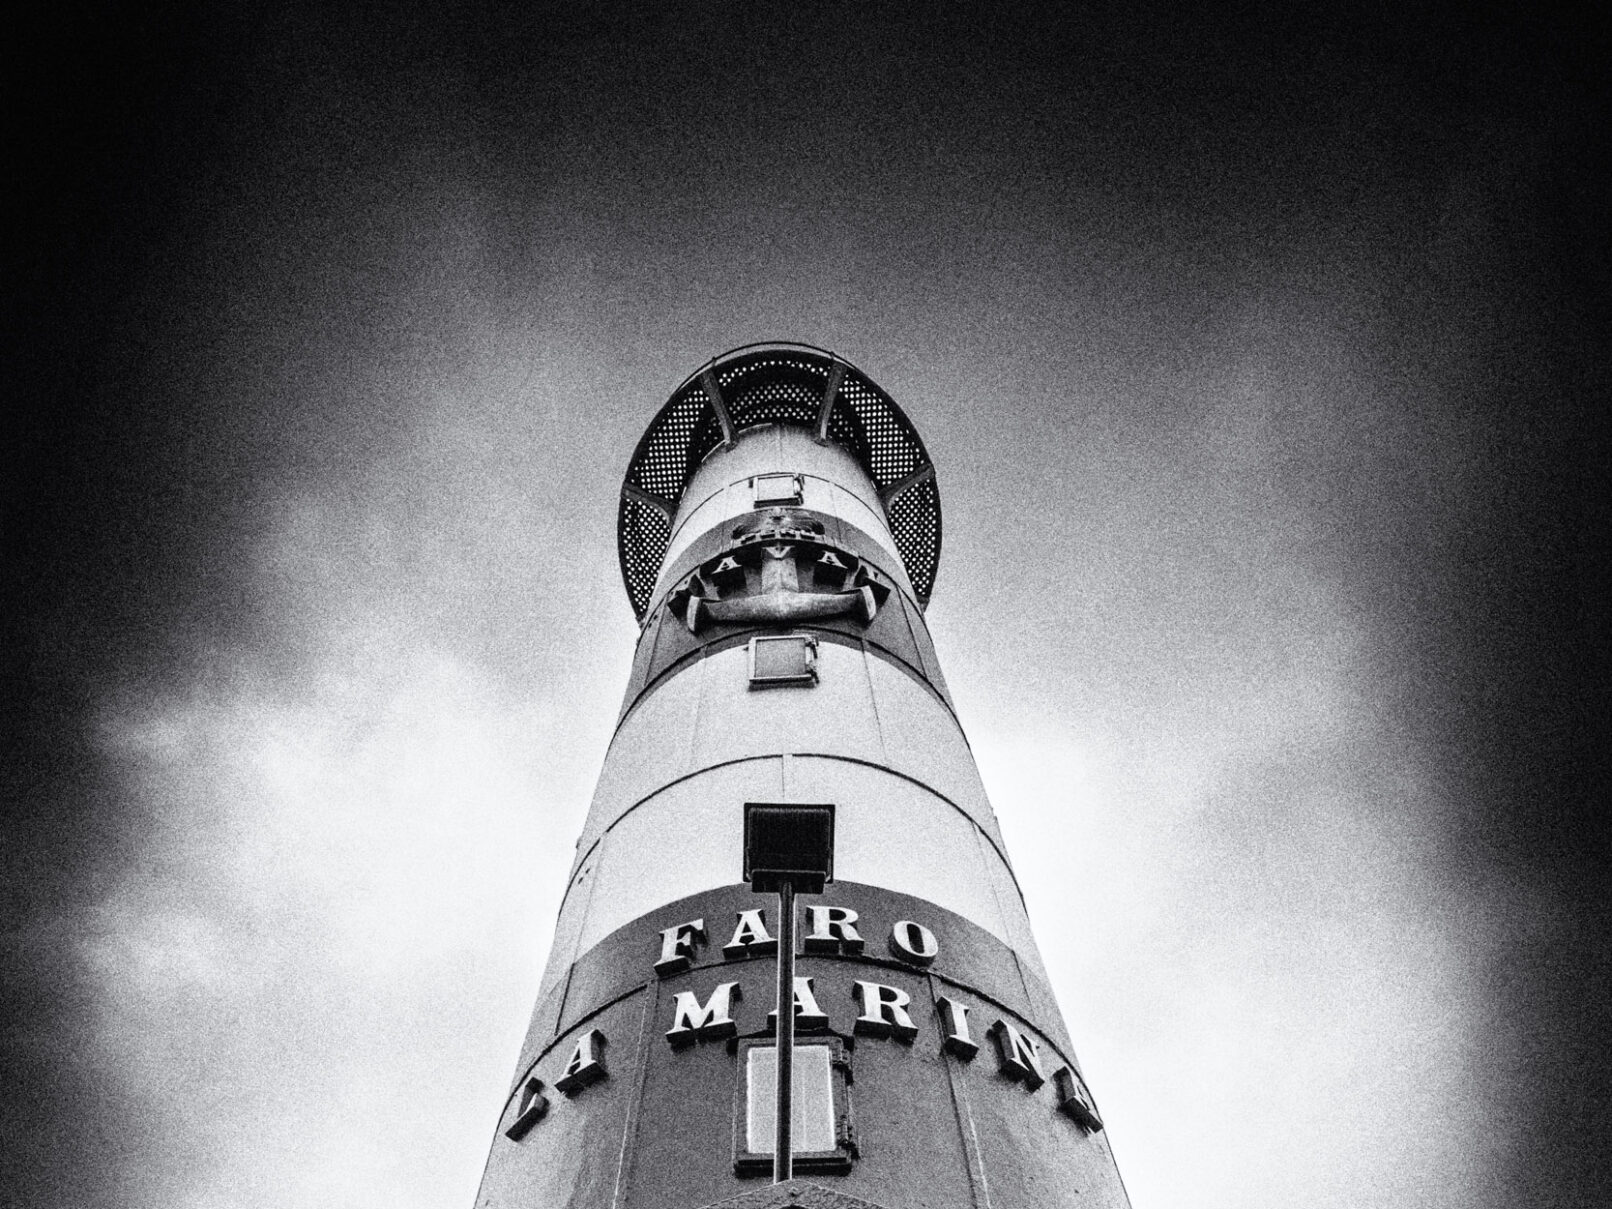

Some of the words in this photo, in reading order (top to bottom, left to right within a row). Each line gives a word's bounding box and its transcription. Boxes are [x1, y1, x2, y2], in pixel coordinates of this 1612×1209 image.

[655, 905, 939, 975] FARO
[505, 1028, 606, 1141] LA
[665, 976, 1103, 1134] MARINA
